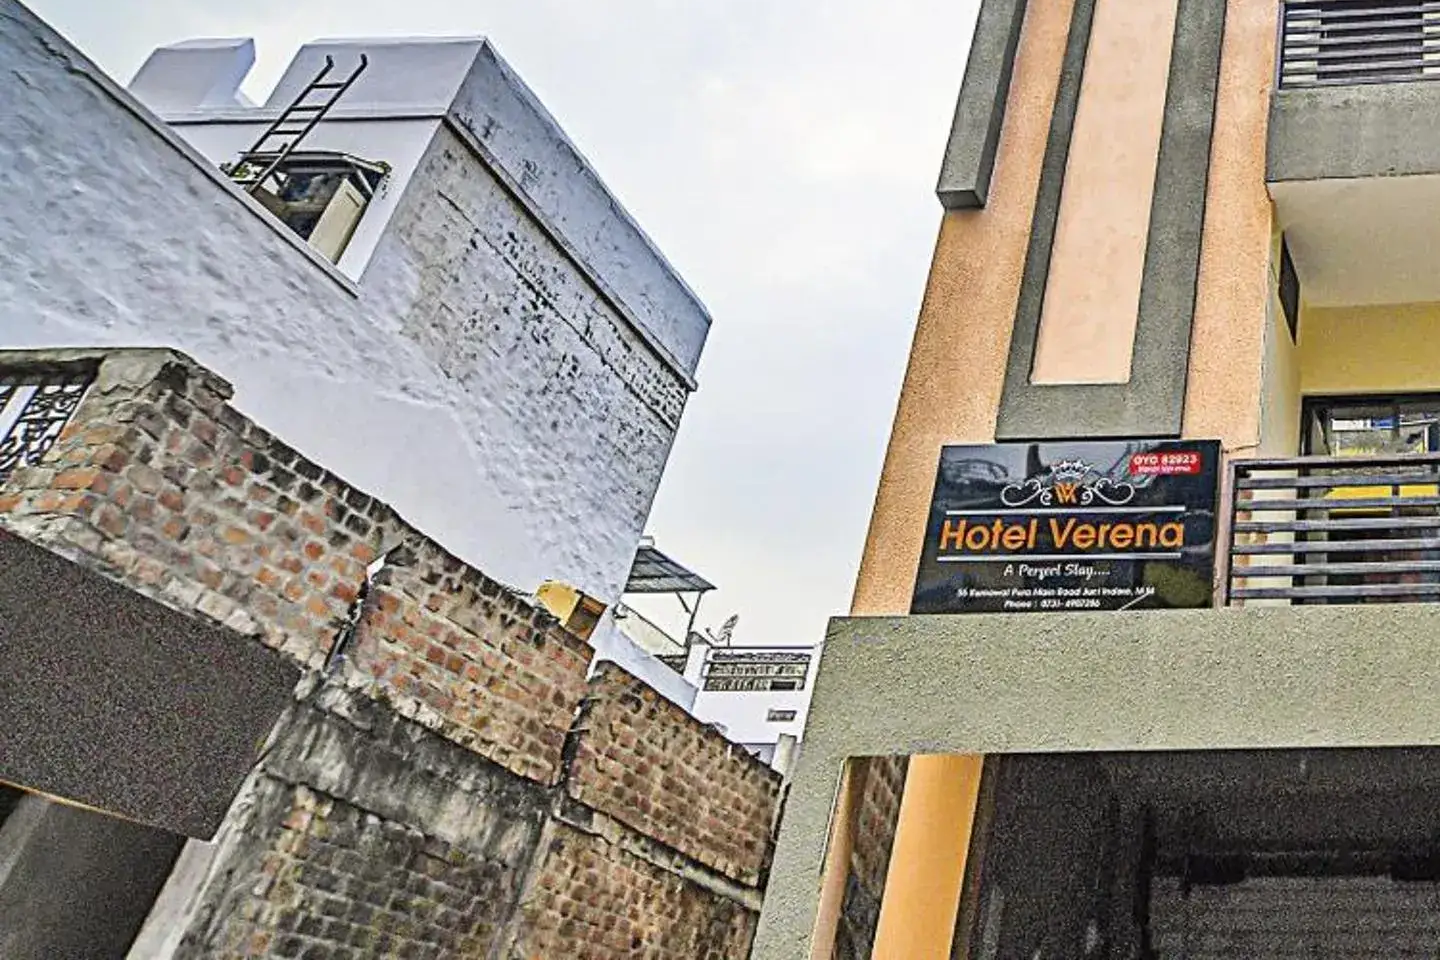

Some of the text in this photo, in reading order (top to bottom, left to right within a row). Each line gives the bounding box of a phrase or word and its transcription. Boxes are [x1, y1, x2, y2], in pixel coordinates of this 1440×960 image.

[1133, 454, 1159, 465] OYO
[939, 517, 1185, 551] Hotel Verena
[1003, 563, 1014, 577] A
